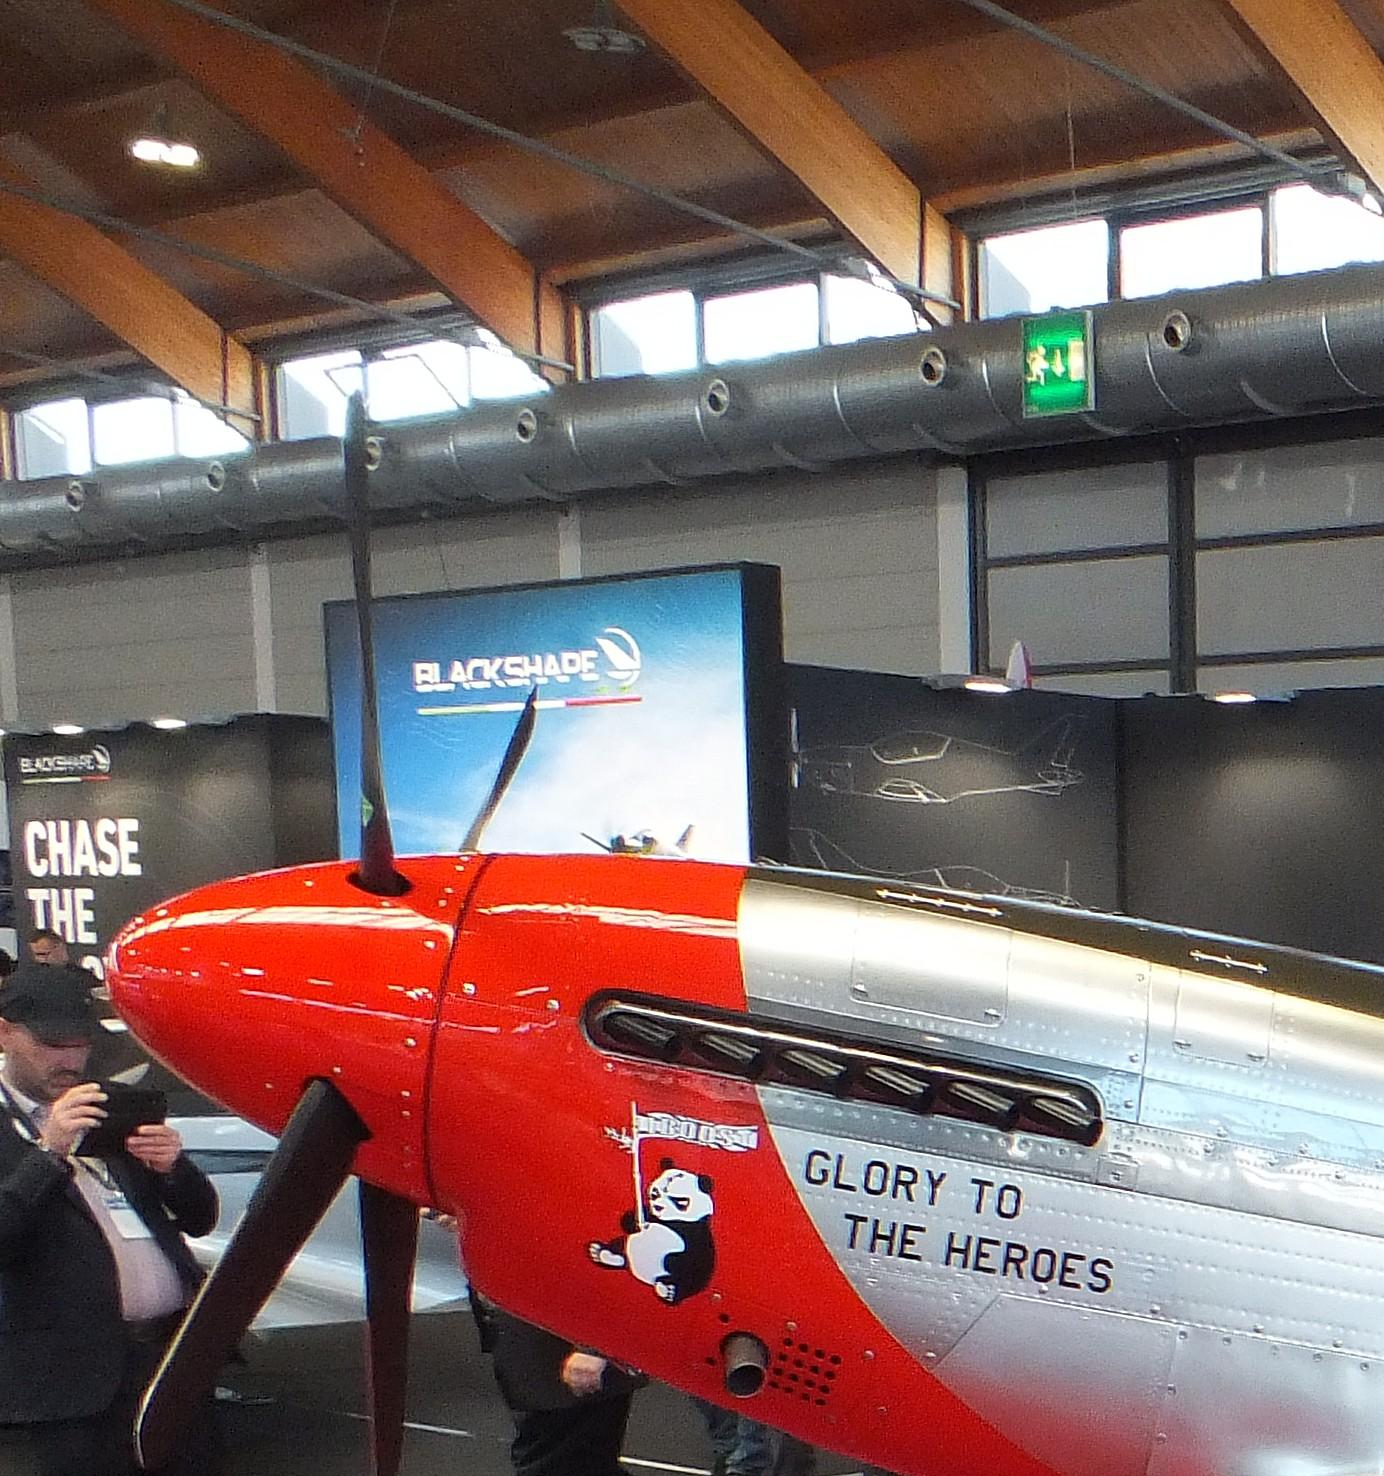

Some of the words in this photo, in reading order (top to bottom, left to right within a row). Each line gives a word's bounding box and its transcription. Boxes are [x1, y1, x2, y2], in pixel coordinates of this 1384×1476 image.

[413, 650, 600, 692] BLACKSHAPE
[25, 818, 143, 877] CHASE
[25, 887, 98, 945] THE
[804, 1149, 948, 1206] GLORY
[971, 1177, 1024, 1220] TO
[844, 1212, 927, 1262] THE
[945, 1231, 1115, 1294] HEROES
